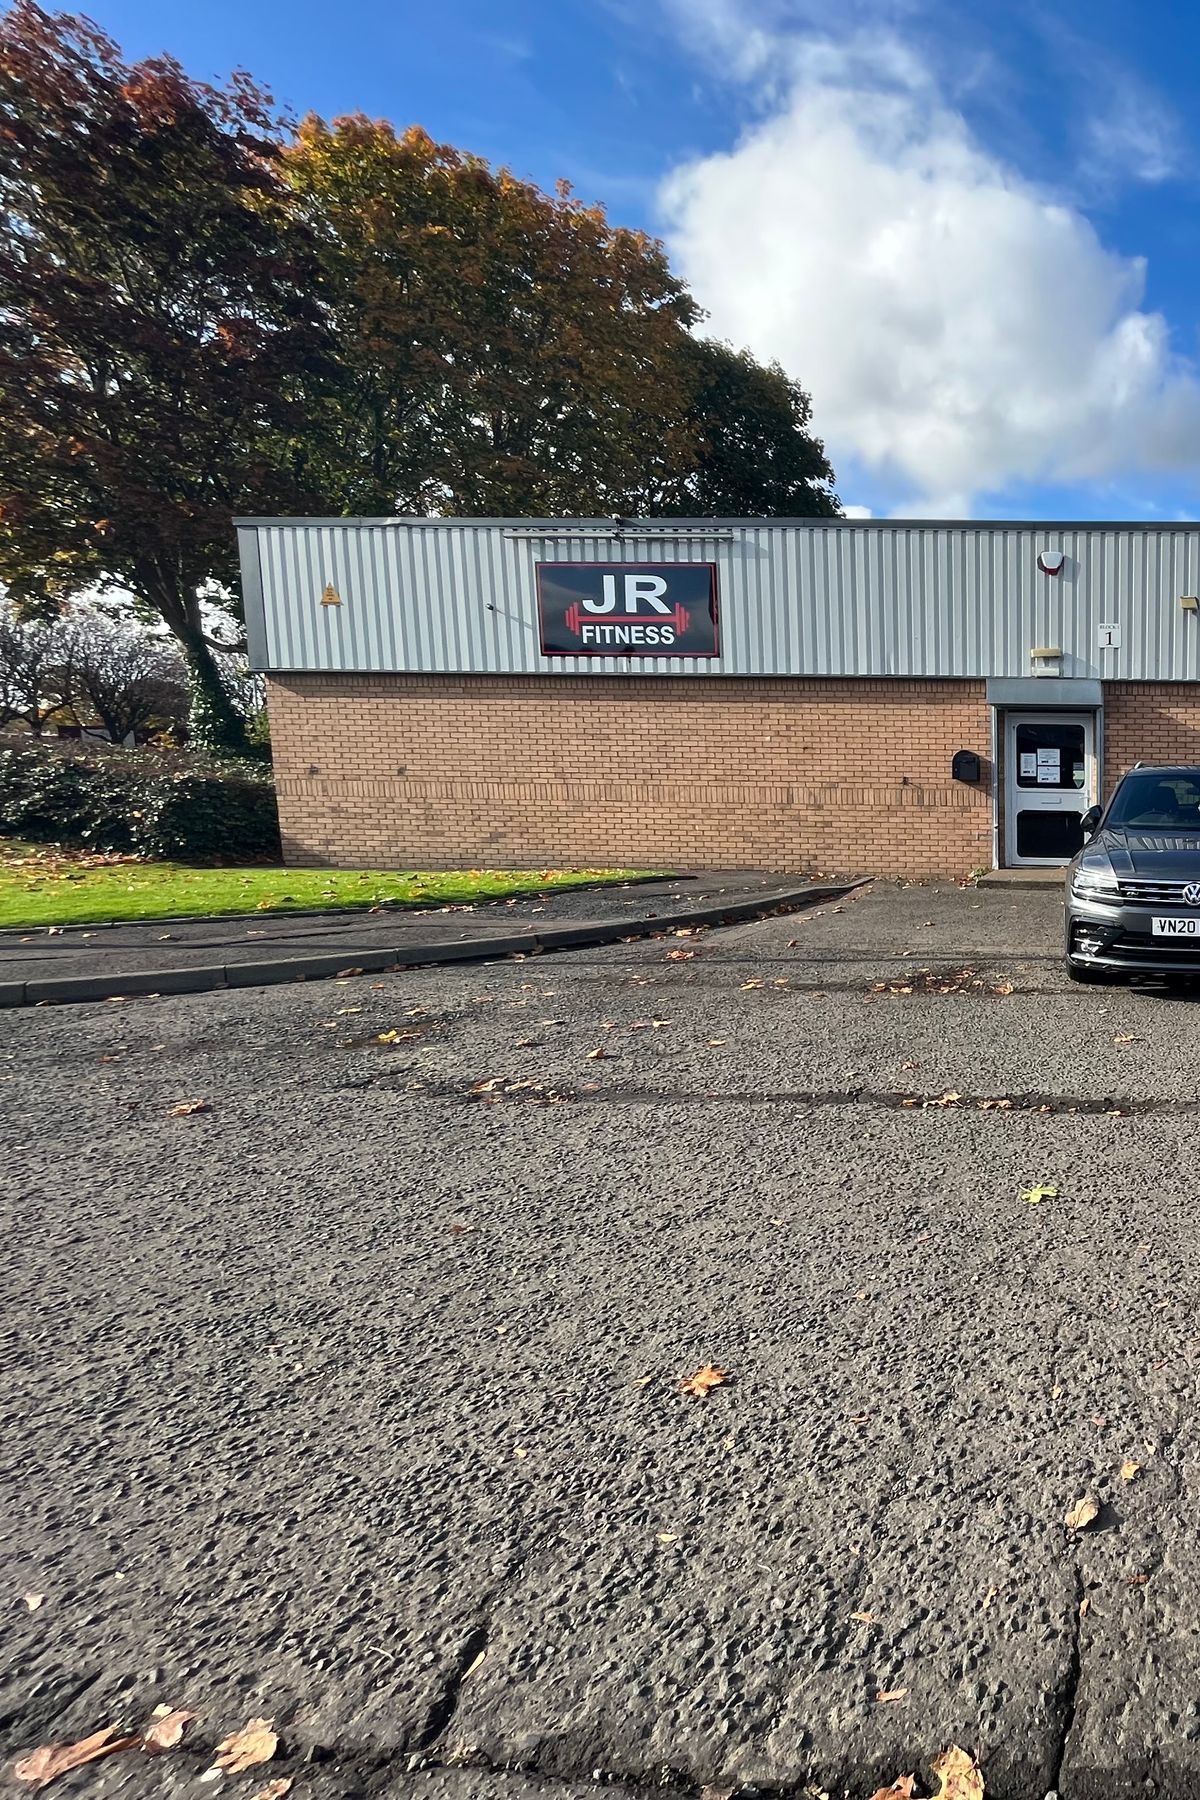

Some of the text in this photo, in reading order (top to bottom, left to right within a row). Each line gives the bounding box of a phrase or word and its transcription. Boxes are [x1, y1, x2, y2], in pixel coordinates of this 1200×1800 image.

[582, 574, 673, 614] JR
[582, 625, 675, 645] FITNESS
[1105, 631, 1114, 646] 1
[1159, 919, 1196, 933] VN20
